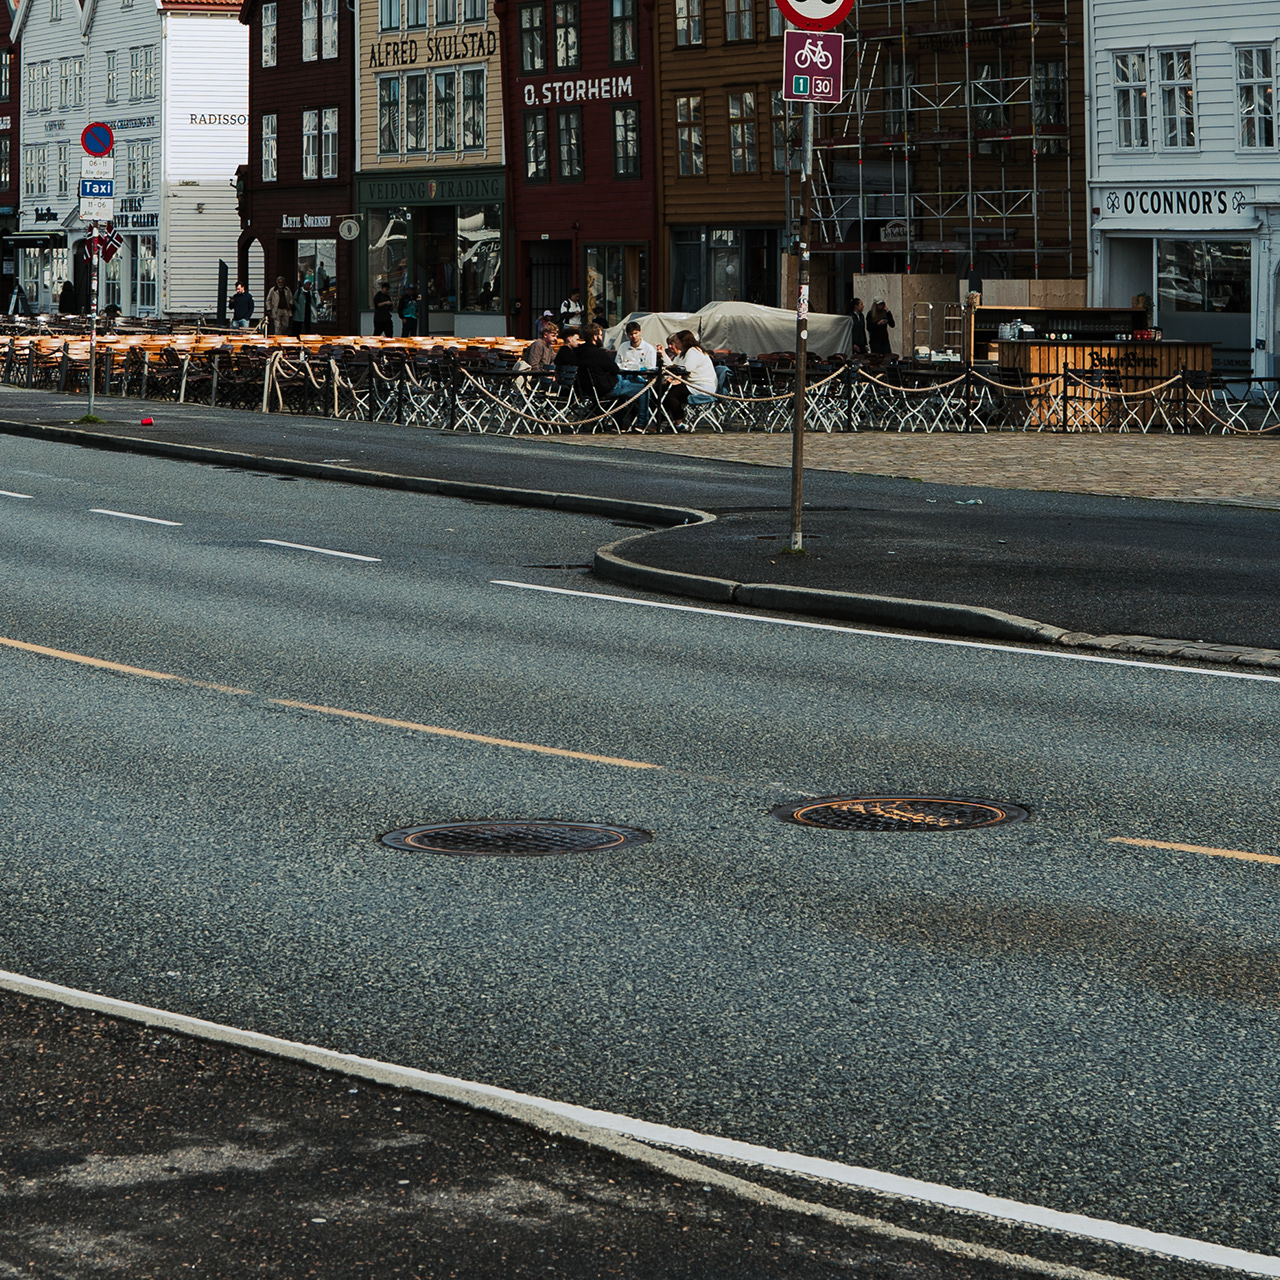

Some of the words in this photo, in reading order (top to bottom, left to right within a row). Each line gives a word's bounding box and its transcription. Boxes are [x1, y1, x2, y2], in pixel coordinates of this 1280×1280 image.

[369, 39, 418, 68] ALFRED
[427, 30, 496, 62] SKULSTAD
[815, 80, 830, 93] 30
[190, 113, 249, 125] RADISSO
[84, 181, 111, 193] Taxi
[368, 182, 425, 200] VEIDUNG
[440, 179, 499, 197] TRADING
[1123, 191, 1228, 214] O'CONNOR'S
[132, 213, 159, 228] GALLERY
[1088, 351, 1158, 370] BakerBrun
